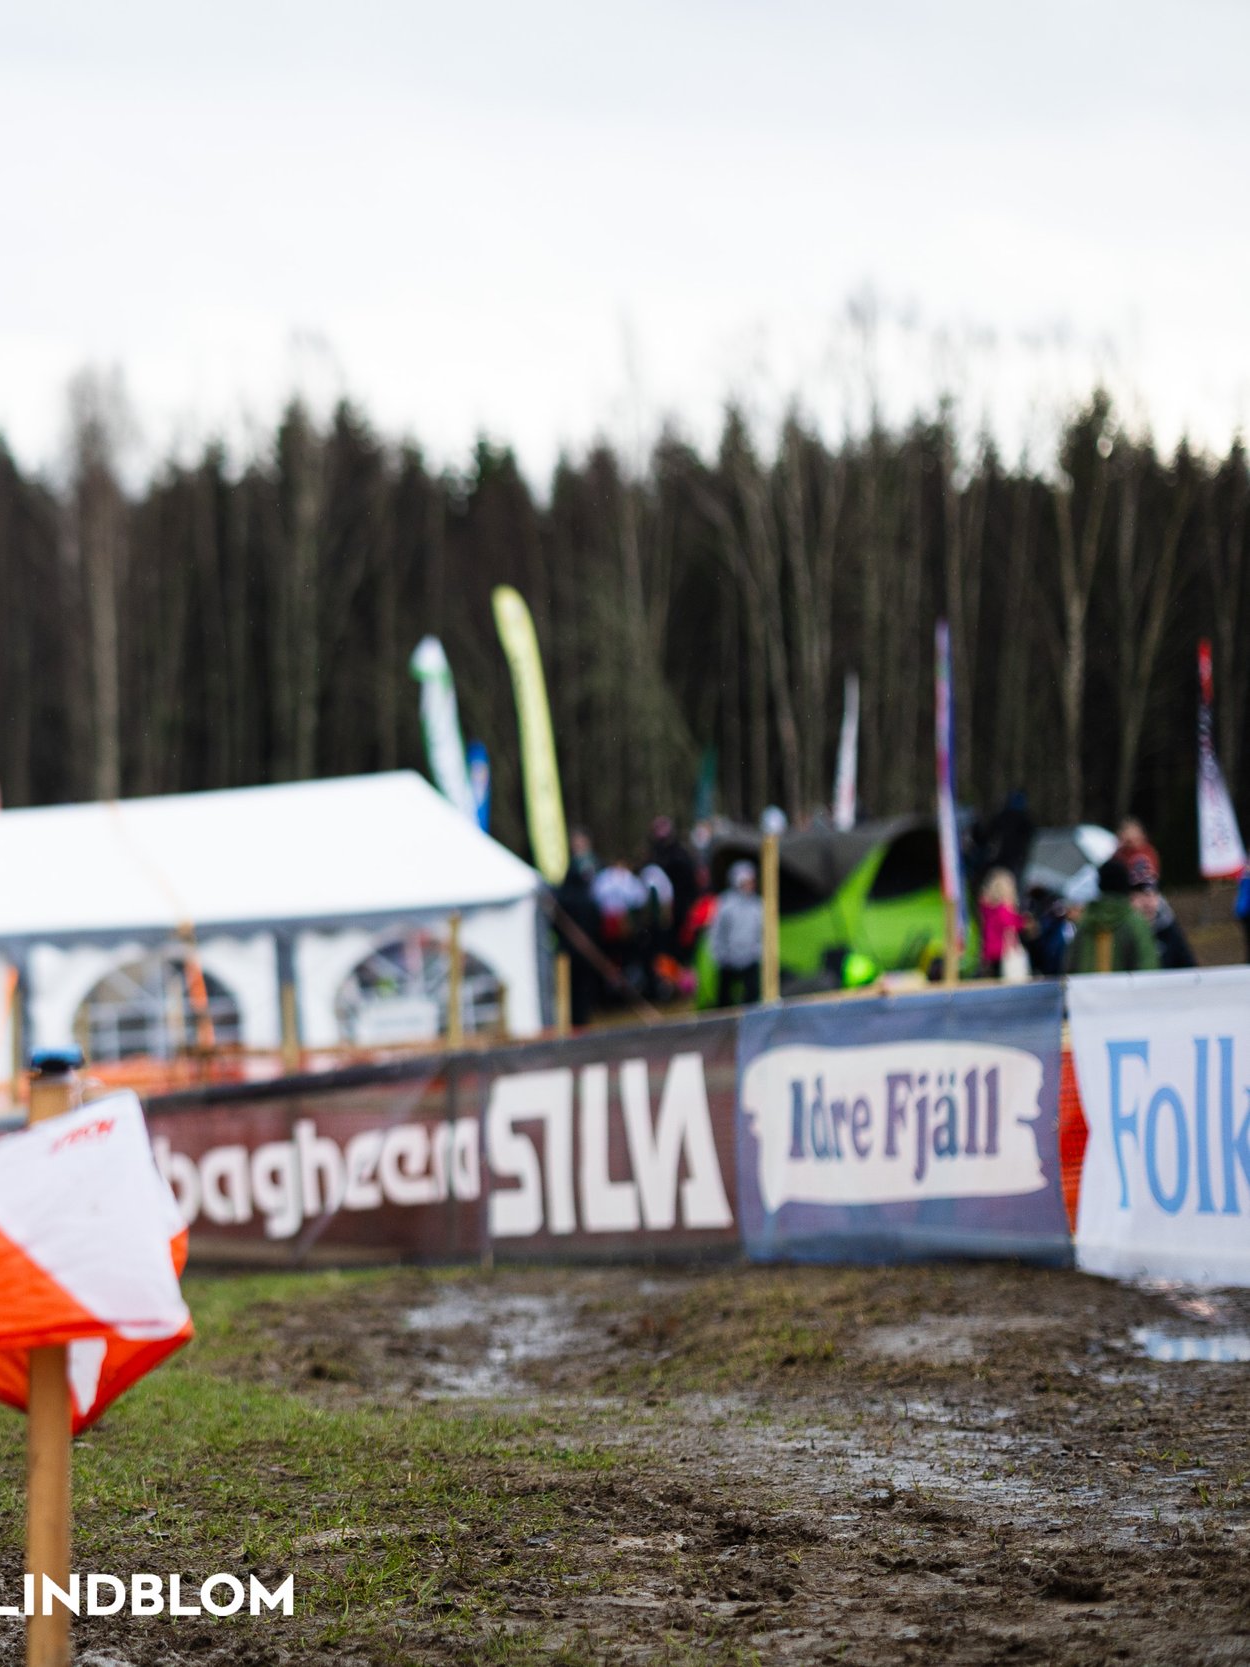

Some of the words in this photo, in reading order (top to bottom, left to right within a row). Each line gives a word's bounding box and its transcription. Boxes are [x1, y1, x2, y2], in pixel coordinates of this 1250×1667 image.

[488, 1054, 733, 1236] SILVA
[789, 1075, 873, 1159] Idre
[884, 1066, 999, 1182] Fjäll
